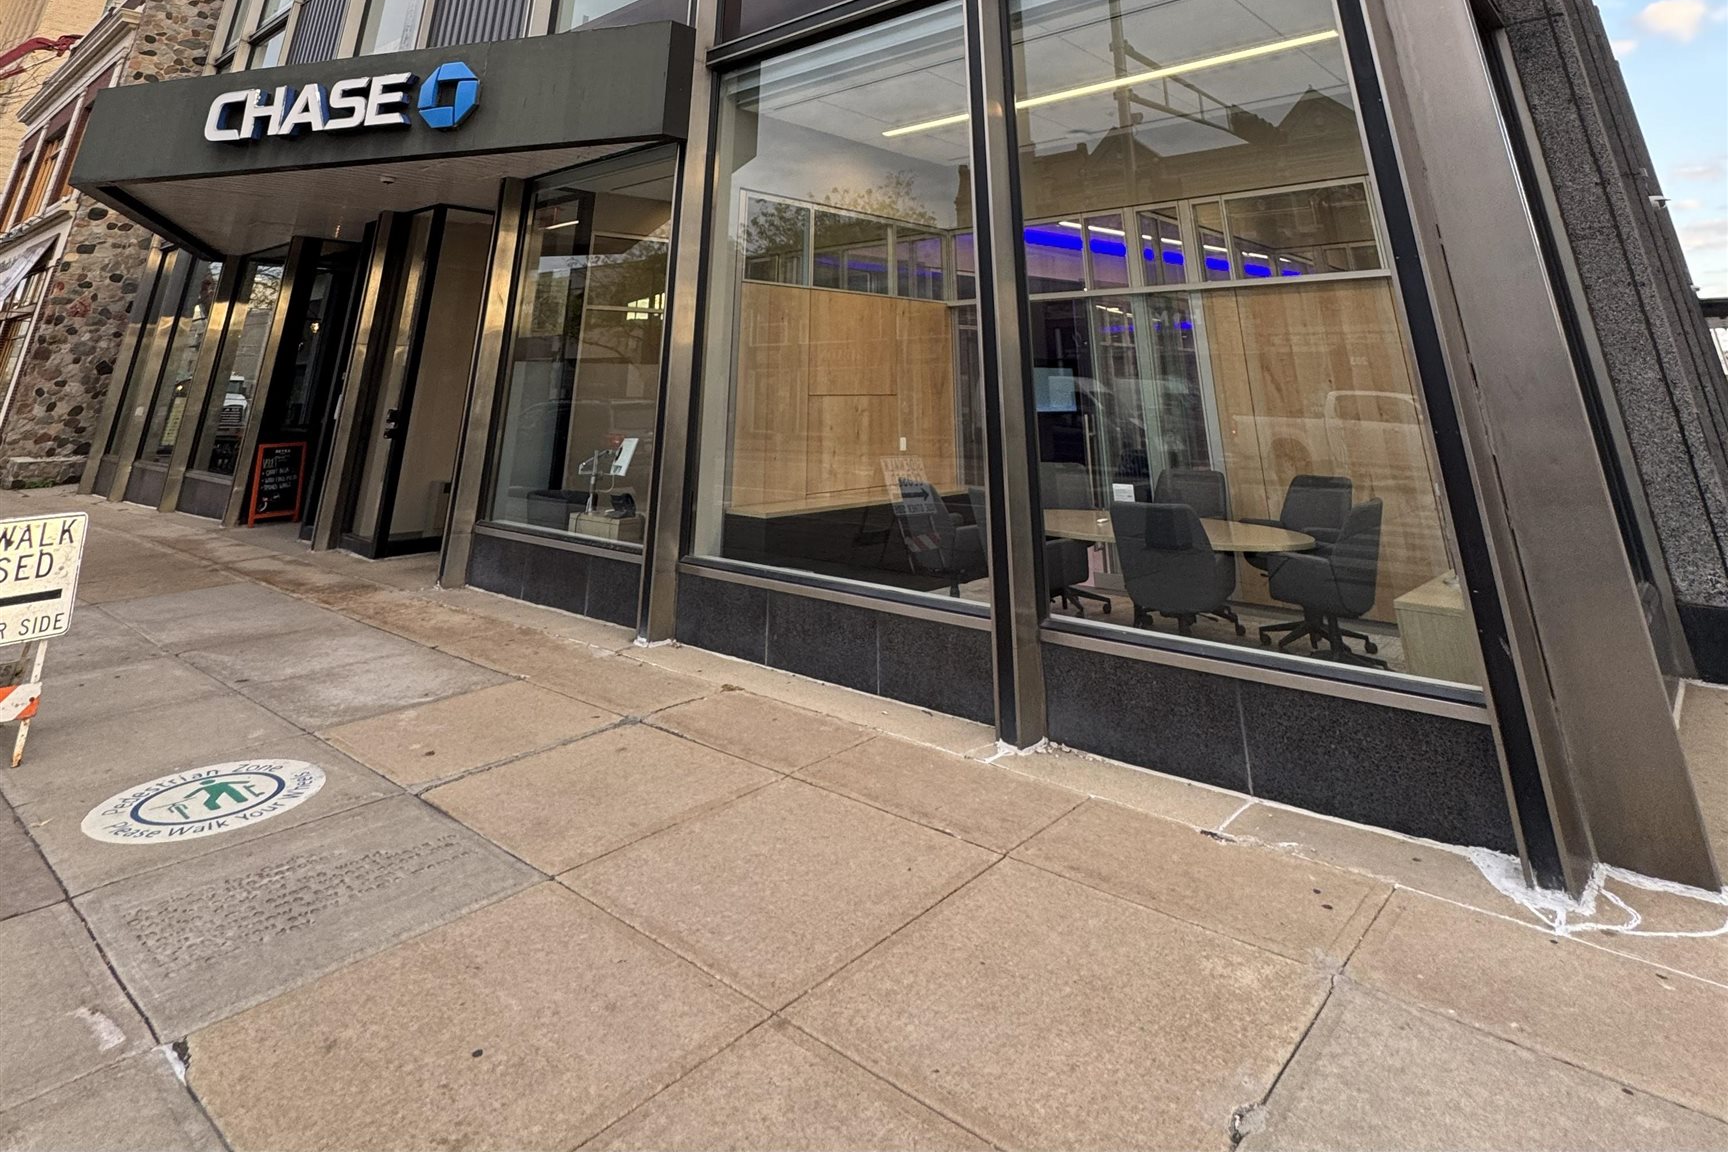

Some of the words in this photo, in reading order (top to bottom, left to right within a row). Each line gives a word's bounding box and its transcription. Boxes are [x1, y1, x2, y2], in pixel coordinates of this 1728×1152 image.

[204, 72, 414, 142] CHASE
[18, 612, 65, 636] SIDE
[101, 769, 219, 816] Pedestrian
[231, 763, 284, 773] Zone
[102, 821, 162, 838] Please
[168, 819, 229, 837] Walk
[235, 801, 286, 821] Your
